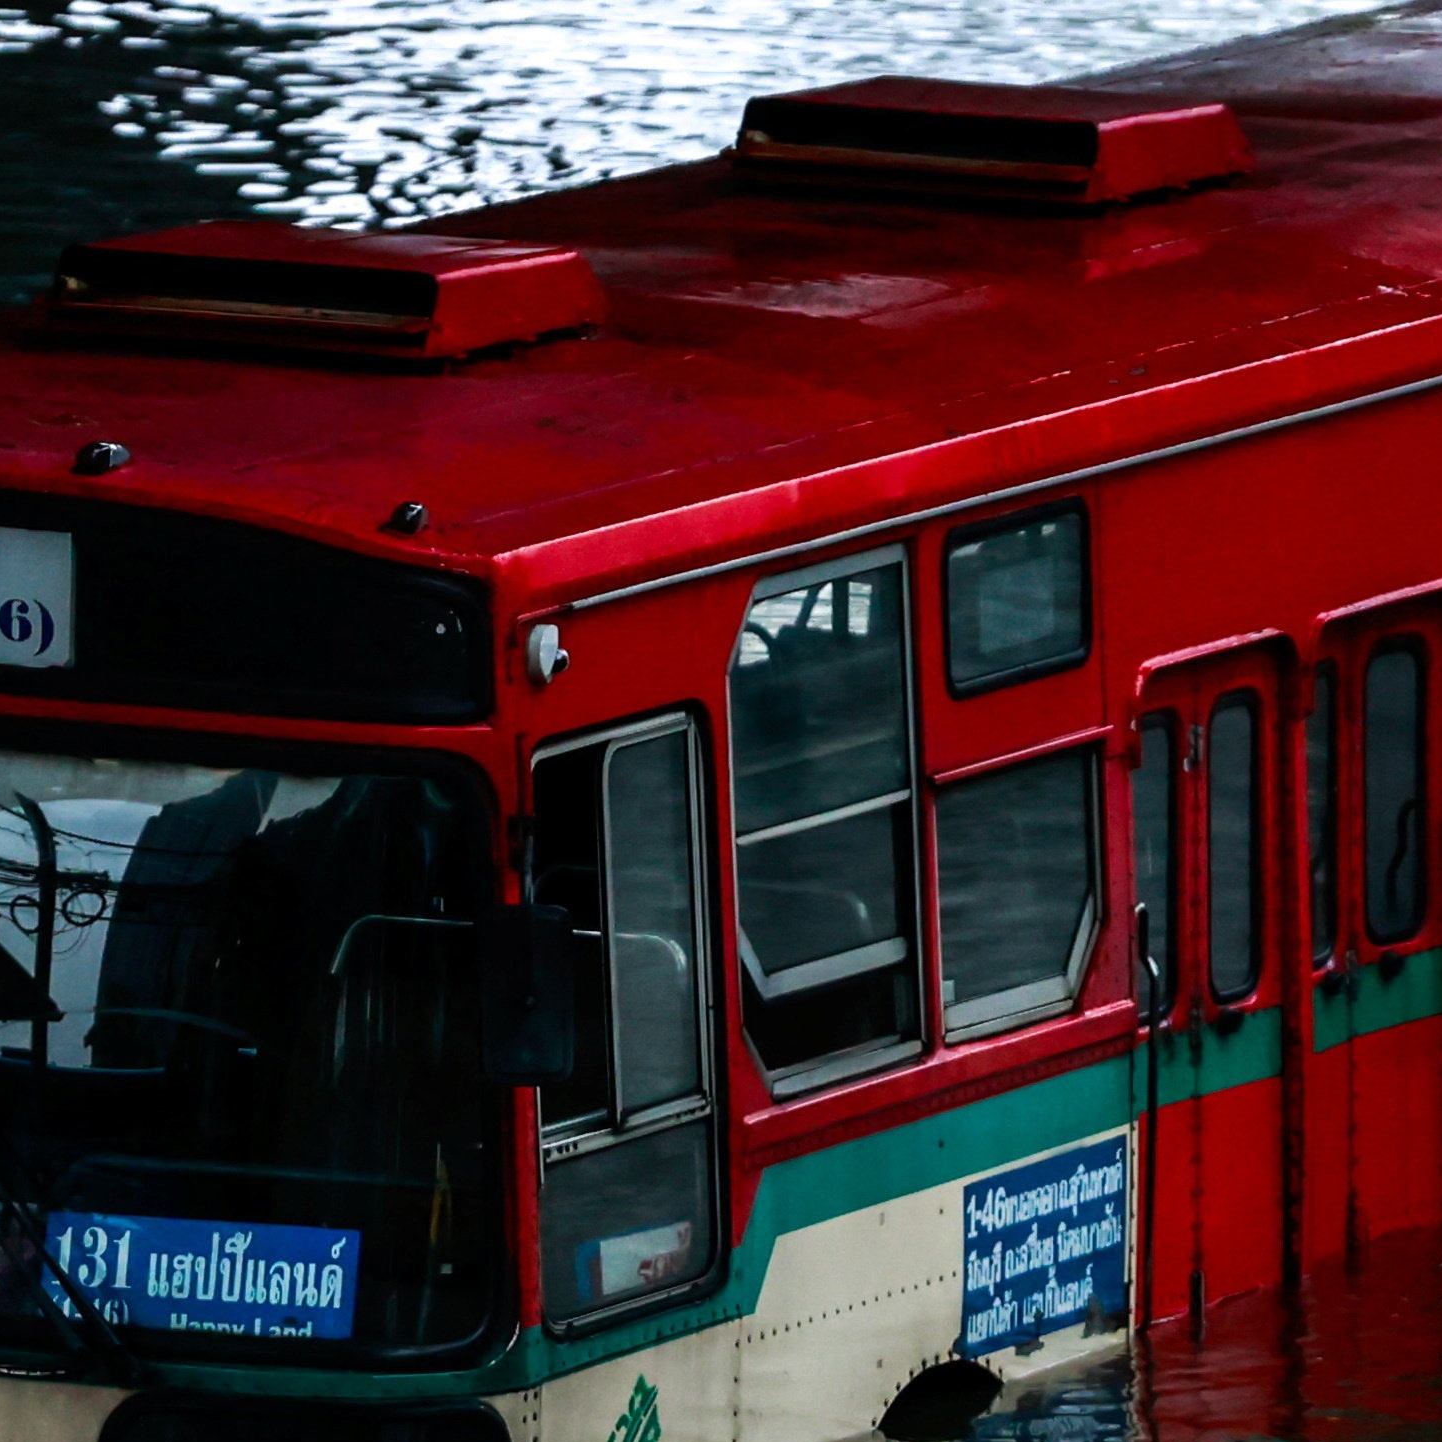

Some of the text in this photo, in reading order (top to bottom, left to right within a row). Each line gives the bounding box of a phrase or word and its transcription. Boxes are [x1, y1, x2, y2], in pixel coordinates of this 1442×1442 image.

[966, 1186, 1006, 1239] 1-46
[51, 1225, 348, 1310] 131 แฮปปี้แลนด์
